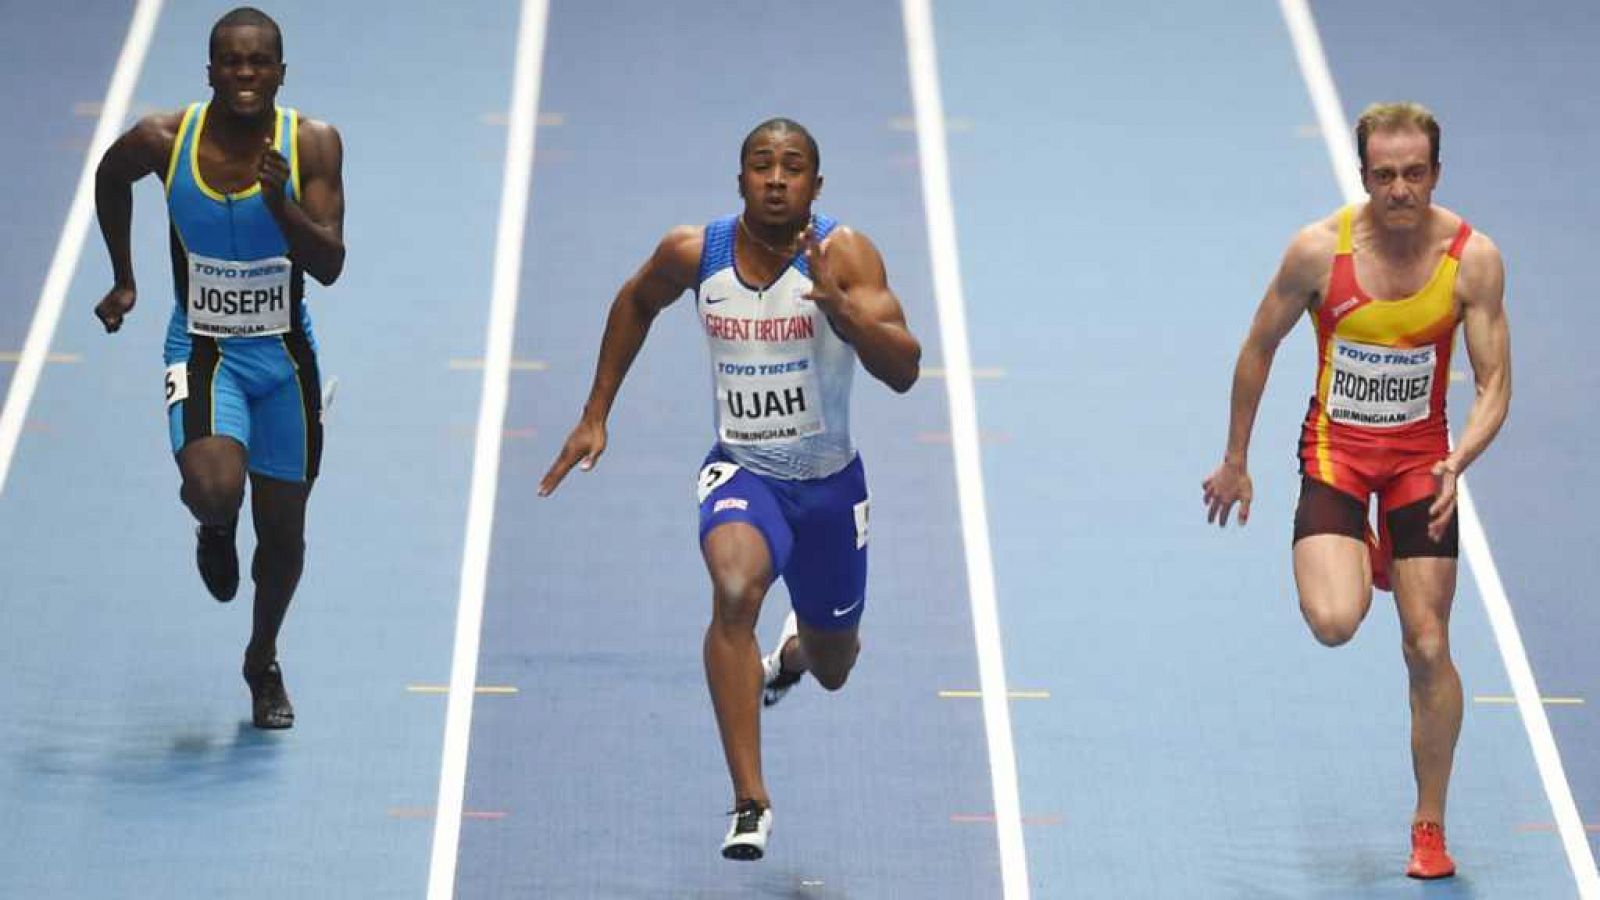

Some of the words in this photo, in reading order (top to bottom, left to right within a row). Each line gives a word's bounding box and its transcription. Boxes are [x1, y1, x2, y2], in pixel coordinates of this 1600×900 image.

[194, 263, 237, 278] TOYO
[193, 286, 284, 315] JOSEPH
[192, 321, 265, 334] BIRMINGHAM
[705, 314, 750, 340] GREAT
[754, 314, 815, 340] BRITAIN
[1339, 346, 1382, 363] TOYO
[1383, 351, 1432, 365] TIRES
[718, 363, 756, 375] TOYO
[759, 360, 808, 374] TIRES
[1333, 370, 1429, 403] RODRÍGUEZ
[727, 386, 806, 419] UJAH
[1332, 408, 1406, 423] BIRMINGHAM
[726, 428, 798, 440] BIRMINGHAM
